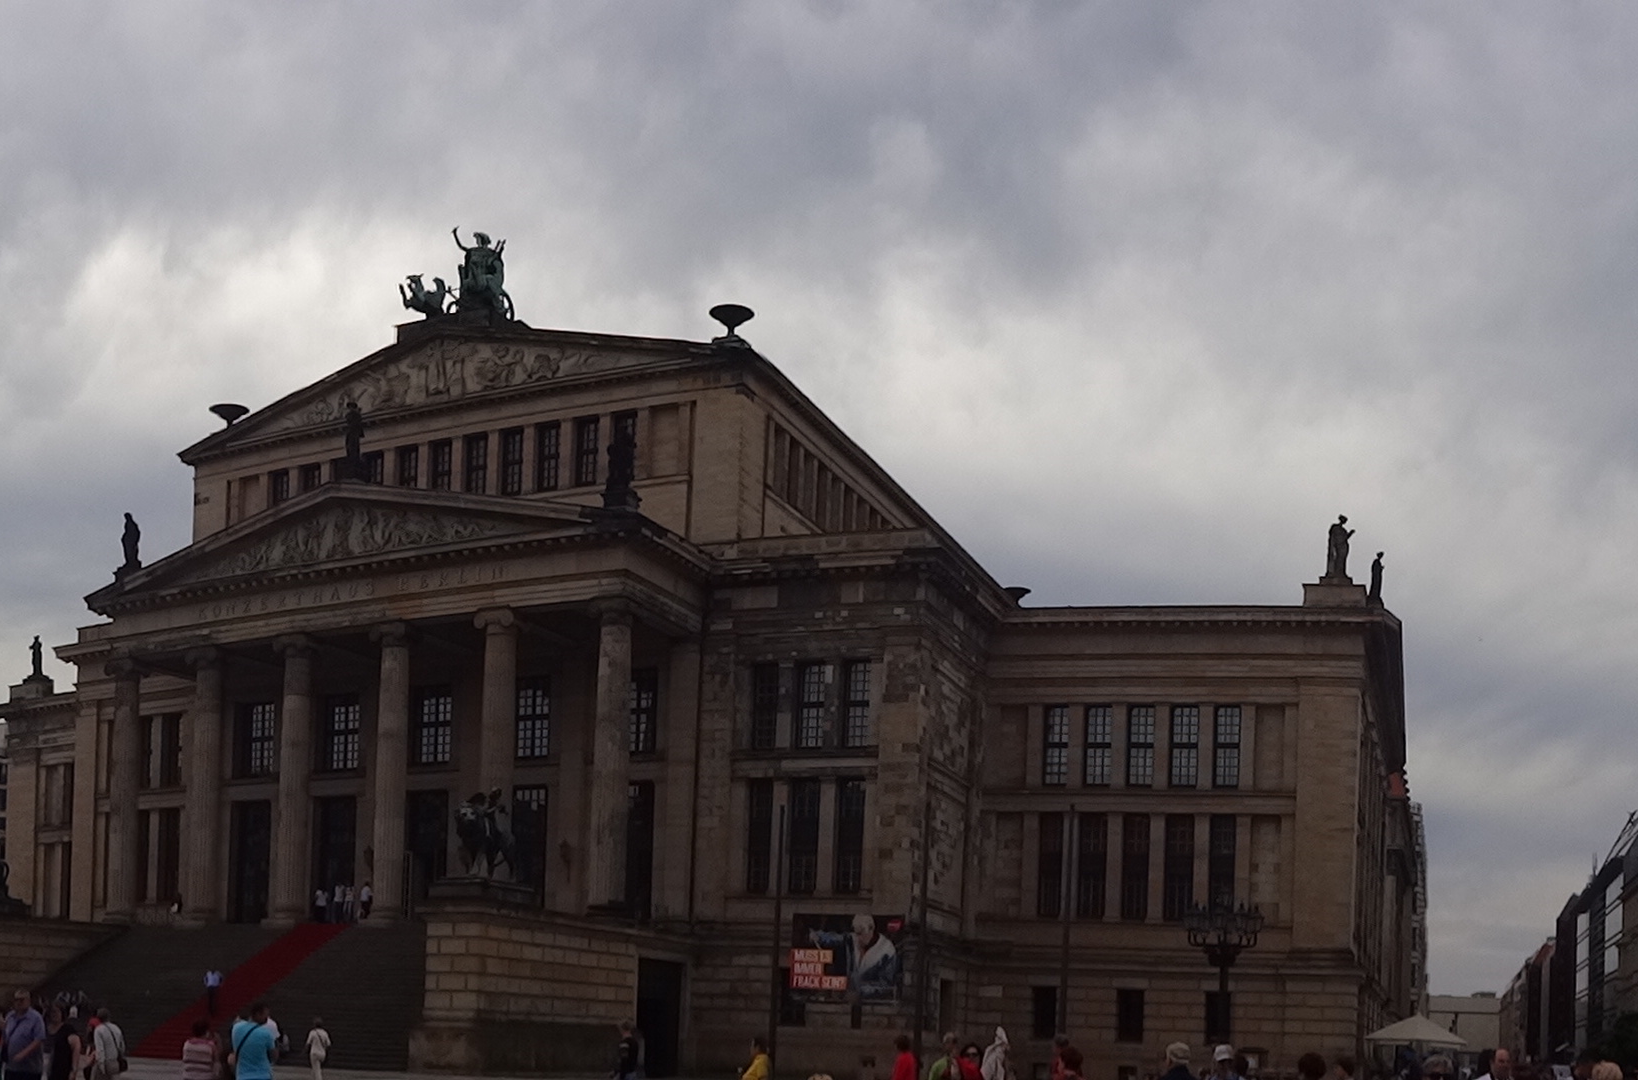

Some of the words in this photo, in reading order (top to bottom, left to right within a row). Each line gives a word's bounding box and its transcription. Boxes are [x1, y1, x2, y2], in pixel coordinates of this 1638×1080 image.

[198, 583, 375, 620] KONZERTHAUS
[397, 565, 505, 592] BERLIN
[794, 949, 818, 962] MUSS
[794, 962, 822, 974] IMMER
[793, 975, 820, 988] FRACK
